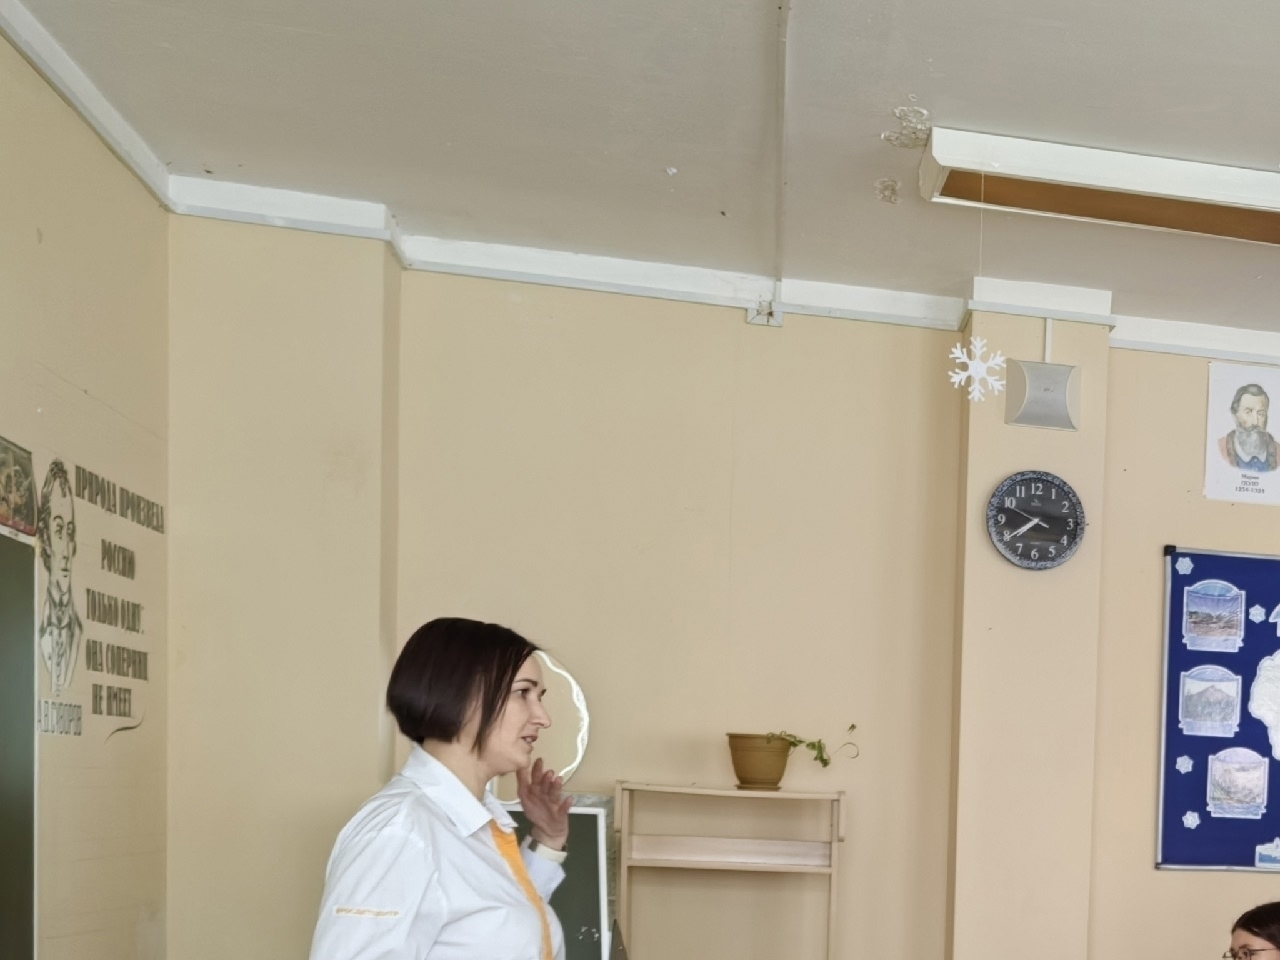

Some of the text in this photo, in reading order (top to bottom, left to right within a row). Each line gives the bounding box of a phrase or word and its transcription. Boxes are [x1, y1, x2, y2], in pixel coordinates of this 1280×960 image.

[1015, 485, 1025, 498] 11
[1031, 483, 1043, 495] 12
[1051, 488, 1056, 500] 1
[75, 464, 165, 535] ПРИРОДА ПРОИЗВЕЛА
[1004, 496, 1016, 508] 10
[1061, 501, 1069, 513] 2
[997, 513, 1006, 526] 9
[1066, 518, 1074, 530] 3
[1003, 530, 1010, 542] 8
[1060, 535, 1068, 547] 4
[1015, 543, 1023, 555] 7
[1030, 548, 1039, 560] 6
[1048, 545, 1057, 558] 5
[101, 538, 136, 581] РОССИЮ
[86, 588, 119, 627] ТОЛЬКО
[85, 638, 104, 672] ОНА
[91, 683, 132, 717] НЕ ИМЕЕТ
